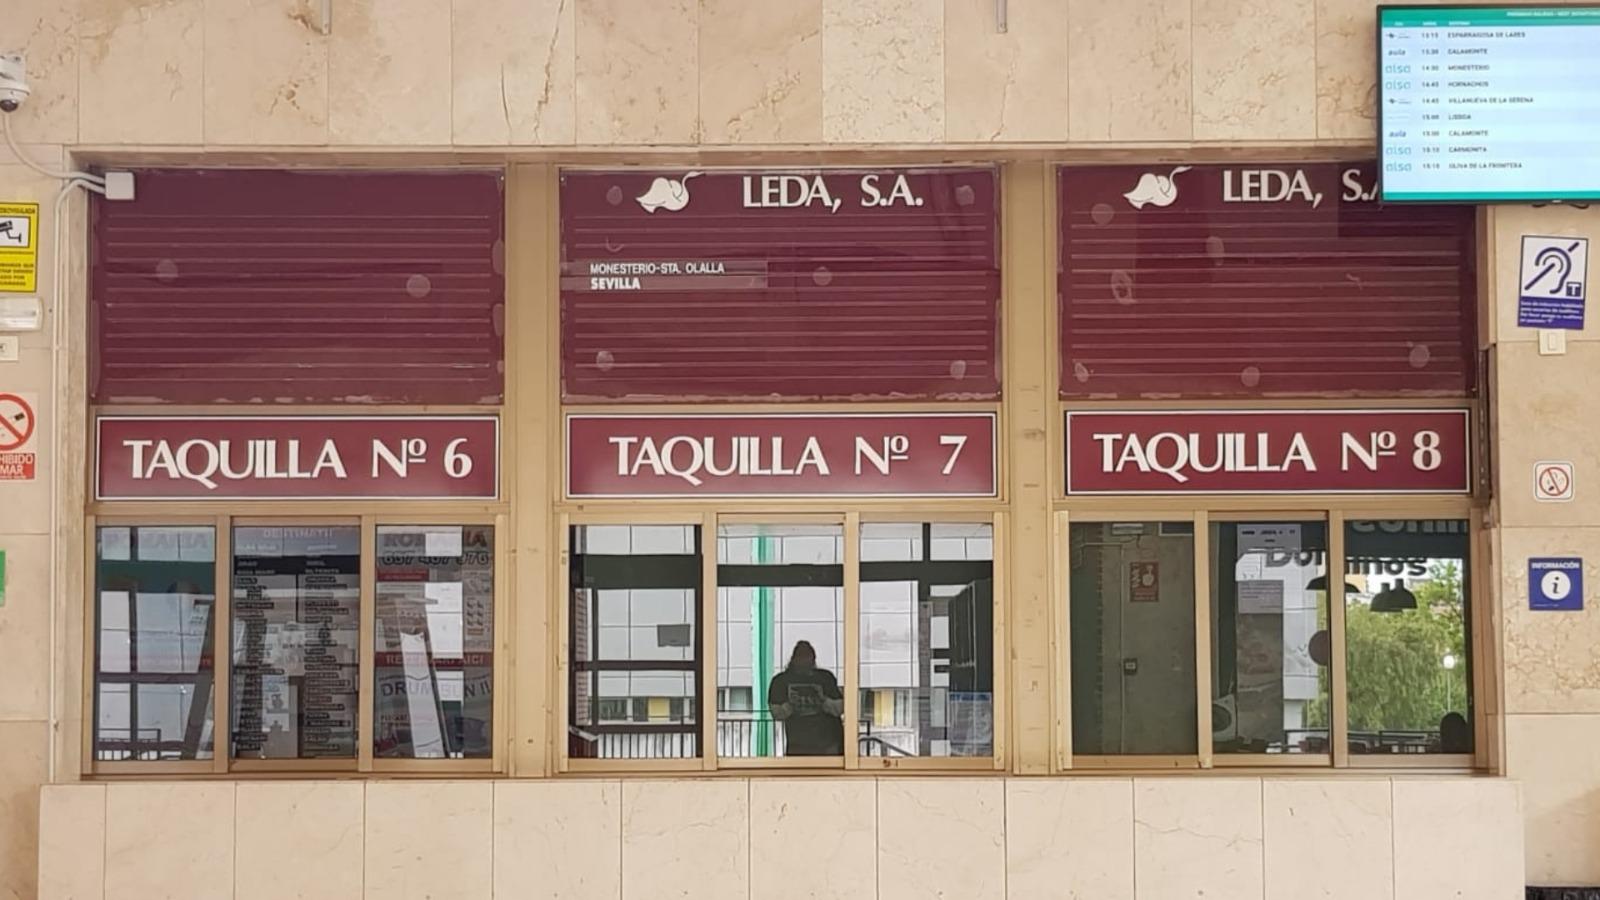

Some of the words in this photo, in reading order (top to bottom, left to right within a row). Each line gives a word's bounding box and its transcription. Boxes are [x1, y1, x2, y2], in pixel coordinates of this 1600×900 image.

[743, 175, 842, 214] LEDA,
[860, 174, 925, 208] S.A.
[1222, 169, 1324, 209] LEDA,
[590, 262, 682, 275] MONESTERIO-STA.
[686, 262, 725, 274] OLALLA
[591, 277, 641, 290] SEVILLA
[123, 438, 348, 490] TAQUILLA
[443, 437, 473, 478] 6
[609, 435, 831, 487] TAQUILLA
[939, 434, 968, 475] 7
[1093, 431, 1318, 483] TAQUILLA
[1412, 430, 1443, 471] 8
